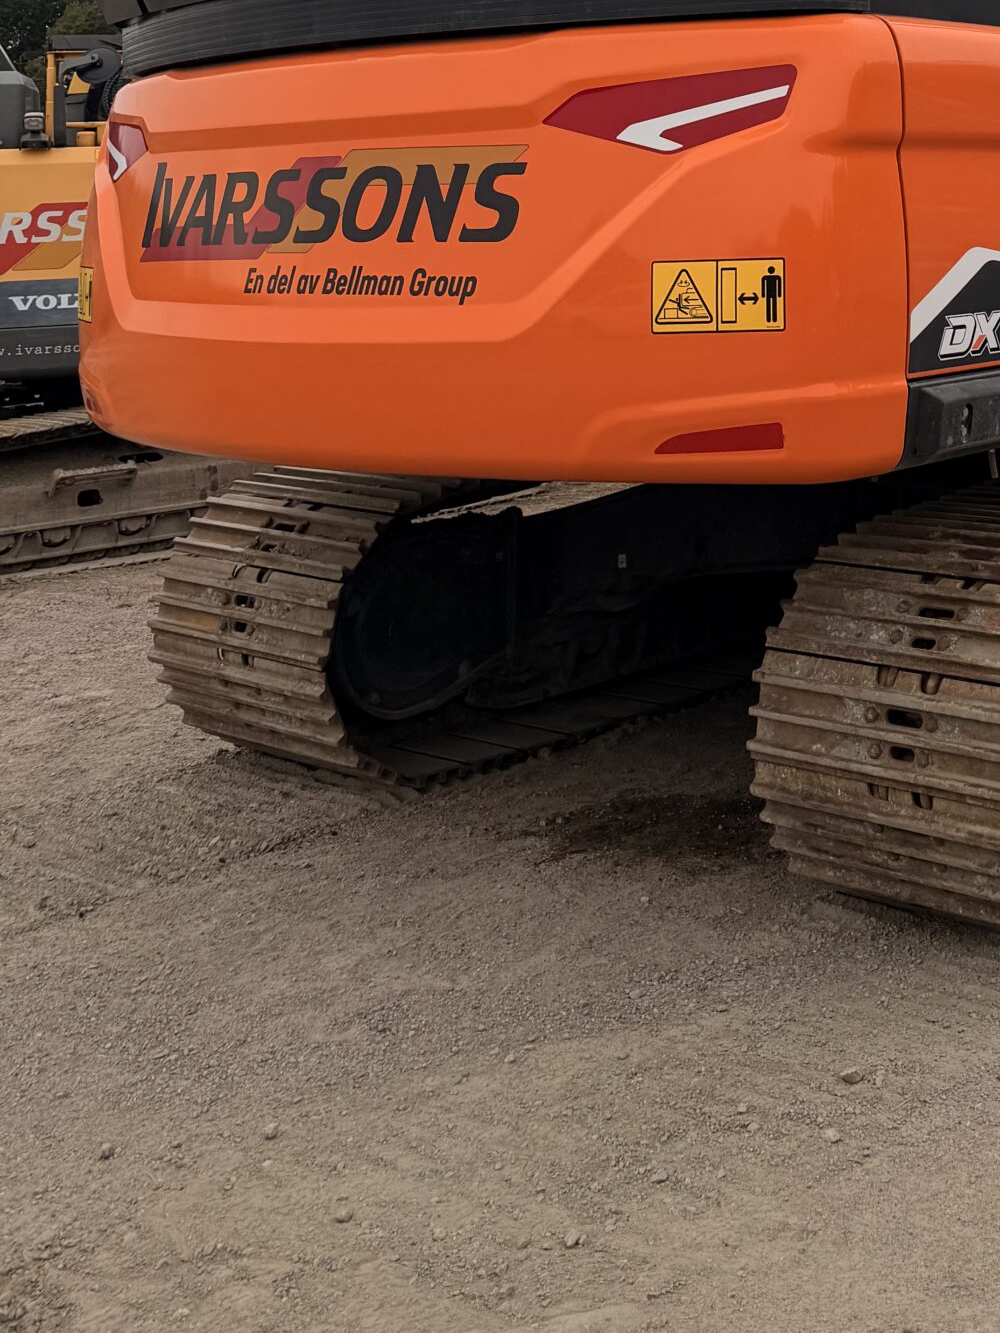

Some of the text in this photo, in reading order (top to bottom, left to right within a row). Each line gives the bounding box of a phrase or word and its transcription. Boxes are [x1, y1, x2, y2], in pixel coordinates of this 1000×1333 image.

[141, 162, 528, 248] IVARSSONS
[8, 293, 79, 311] VOL
[243, 265, 478, 306] En del av Bellman Group
